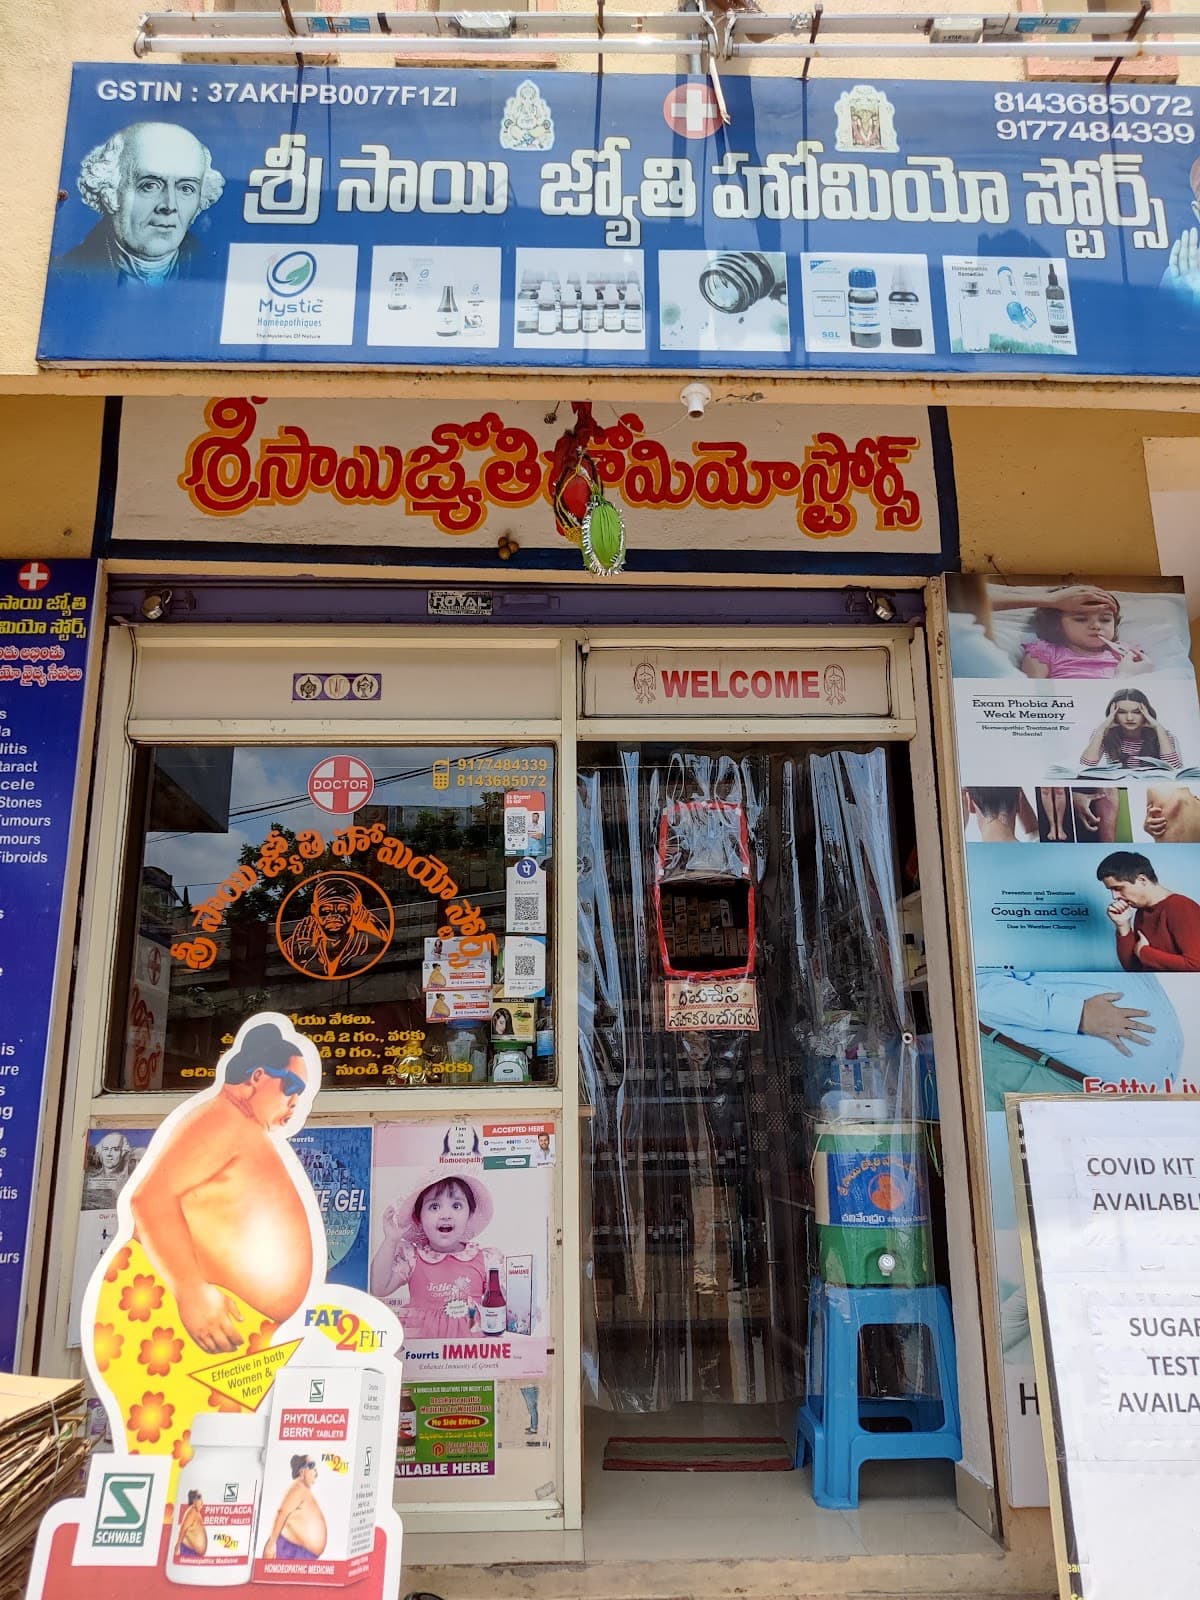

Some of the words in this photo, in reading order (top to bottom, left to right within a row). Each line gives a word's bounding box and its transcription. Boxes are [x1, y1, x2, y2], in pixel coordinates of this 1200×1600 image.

[98, 81, 183, 102] GSTIN
[207, 83, 457, 107] 37AKHPB0077F1ZI
[994, 92, 1194, 116] 8143685072
[996, 119, 1195, 144] 9177484339
[243, 134, 324, 224] శ్రీ
[336, 144, 509, 214] సాయి
[540, 136, 697, 247] జ్యోతి
[711, 140, 1011, 224] హోమియో
[1022, 154, 1169, 259] స్టోర్స్
[259, 298, 323, 317] Mystic
[256, 424, 404, 506] సాయి
[403, 411, 543, 535] జ్యోతి
[432, 596, 488, 608] ROYAL
[661, 670, 820, 699] WELCOME
[972, 699, 1005, 708] Exam
[1008, 699, 1048, 708] Phobia
[1051, 700, 1074, 708] And
[984, 710, 1016, 719] Weak
[1019, 710, 1065, 720] Memory
[458, 759, 548, 771] 9177484339
[313, 780, 368, 790] DOCTOR
[457, 775, 547, 787] 8143685072
[991, 907, 1031, 918] Cough
[1034, 907, 1057, 916] and
[1060, 907, 1089, 916] Cold
[1087, 1157, 1156, 1176] COVID
[1162, 1157, 1195, 1176] KIT
[335, 1189, 367, 1212] GEL
[304, 1309, 343, 1326] FAT
[336, 1314, 360, 1351] 2
[359, 1331, 388, 1348] FIT
[406, 1351, 439, 1360] Fourrts
[443, 1343, 511, 1360] IMMUNE
[211, 1361, 252, 1382] Effective
[252, 1357, 262, 1368] in
[263, 1350, 285, 1365] both
[1146, 1356, 1200, 1376] TEST
[227, 1372, 263, 1390] Women
[265, 1367, 273, 1378] &
[242, 1385, 263, 1399] Men
[283, 1413, 346, 1425] PHYTOLACCA
[443, 1418, 457, 1426] Side
[458, 1417, 480, 1425] Effects
[282, 1427, 314, 1438] BERRY
[316, 1429, 344, 1438] TABLETS
[321, 1454, 334, 1462] FAT
[332, 1455, 341, 1472] 2
[453, 1461, 488, 1474] HERE
[205, 1506, 252, 1514] PHYTOLACCA
[204, 1516, 229, 1525] BERRY
[95, 1531, 142, 1544] SCHWABE
[213, 1533, 226, 1541] FAT
[224, 1536, 232, 1548] 2
